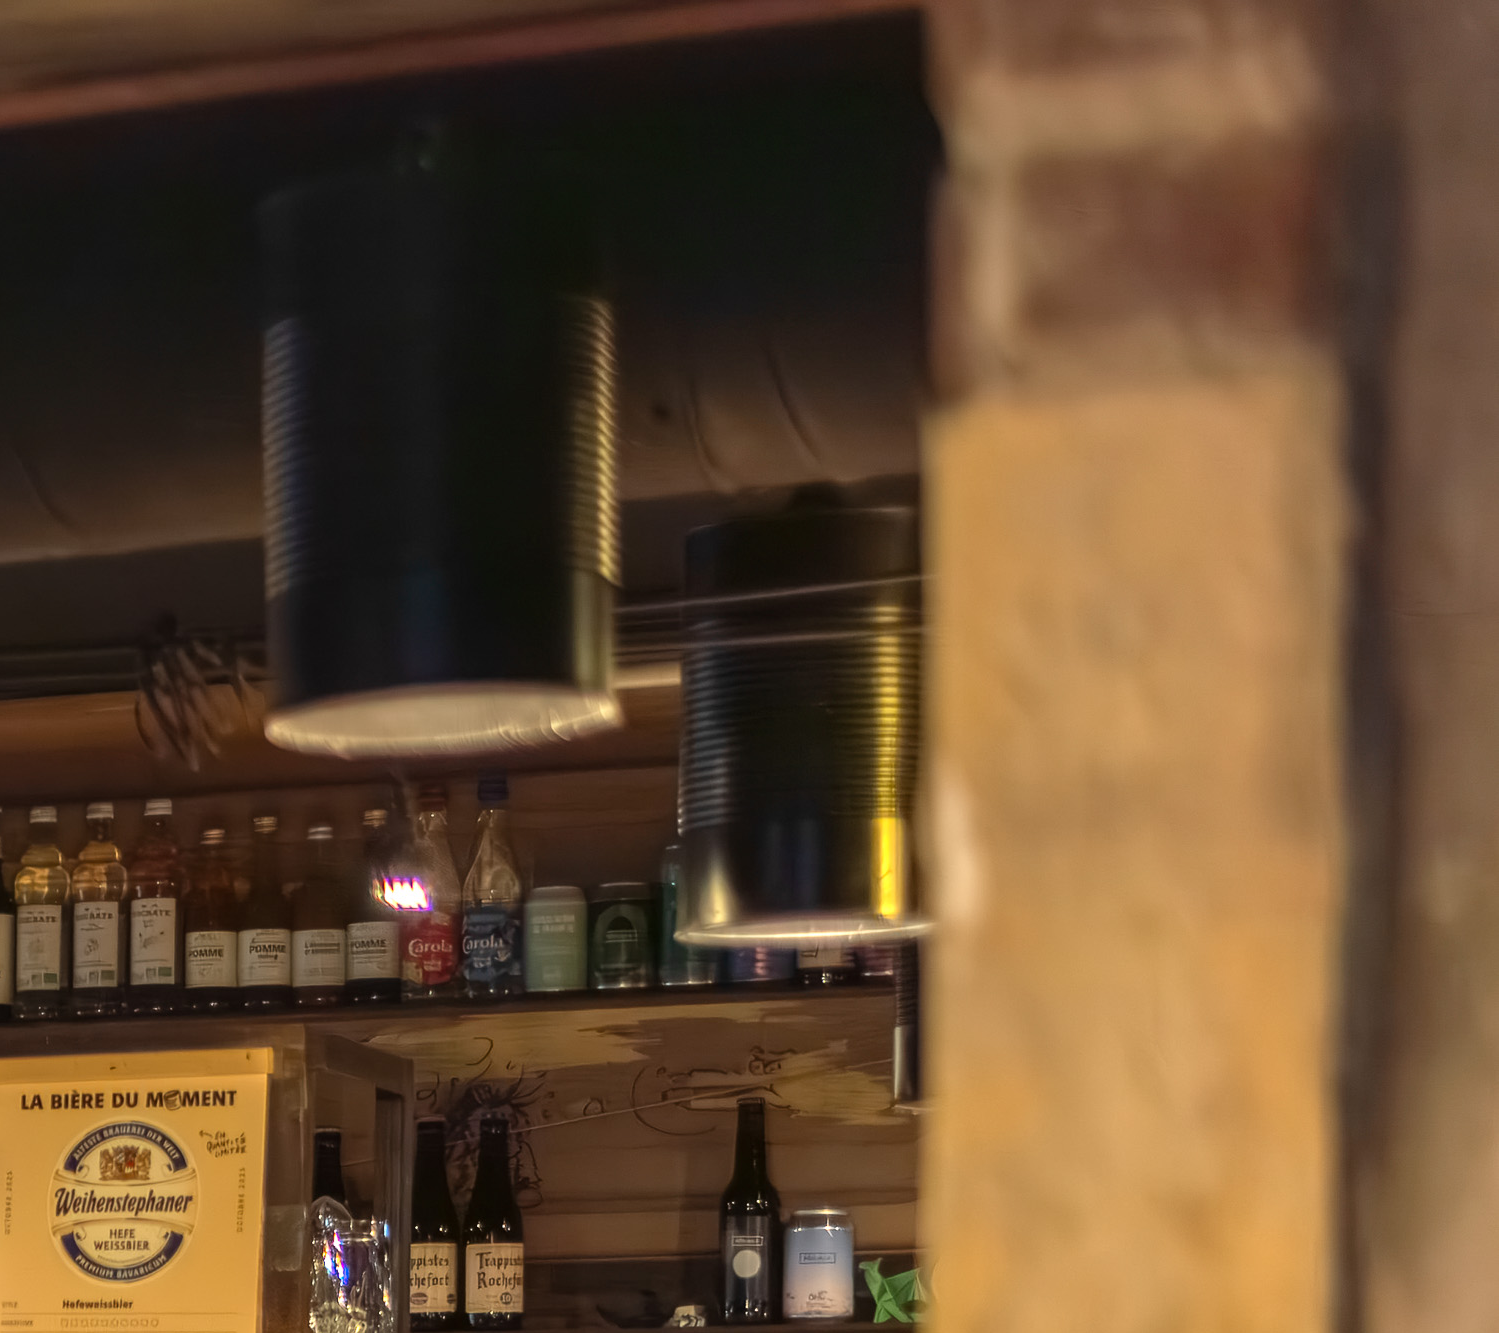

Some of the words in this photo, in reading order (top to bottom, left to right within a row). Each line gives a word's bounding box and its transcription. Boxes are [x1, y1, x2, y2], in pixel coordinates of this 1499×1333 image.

[20, 1094, 44, 1111] LA
[50, 1089, 105, 1110] BIÈRE
[111, 1092, 138, 1108] DU
[54, 1187, 194, 1217] Weihenstephaner
[109, 1229, 136, 1239] HEFE
[93, 1240, 150, 1251] WEISSBIER
